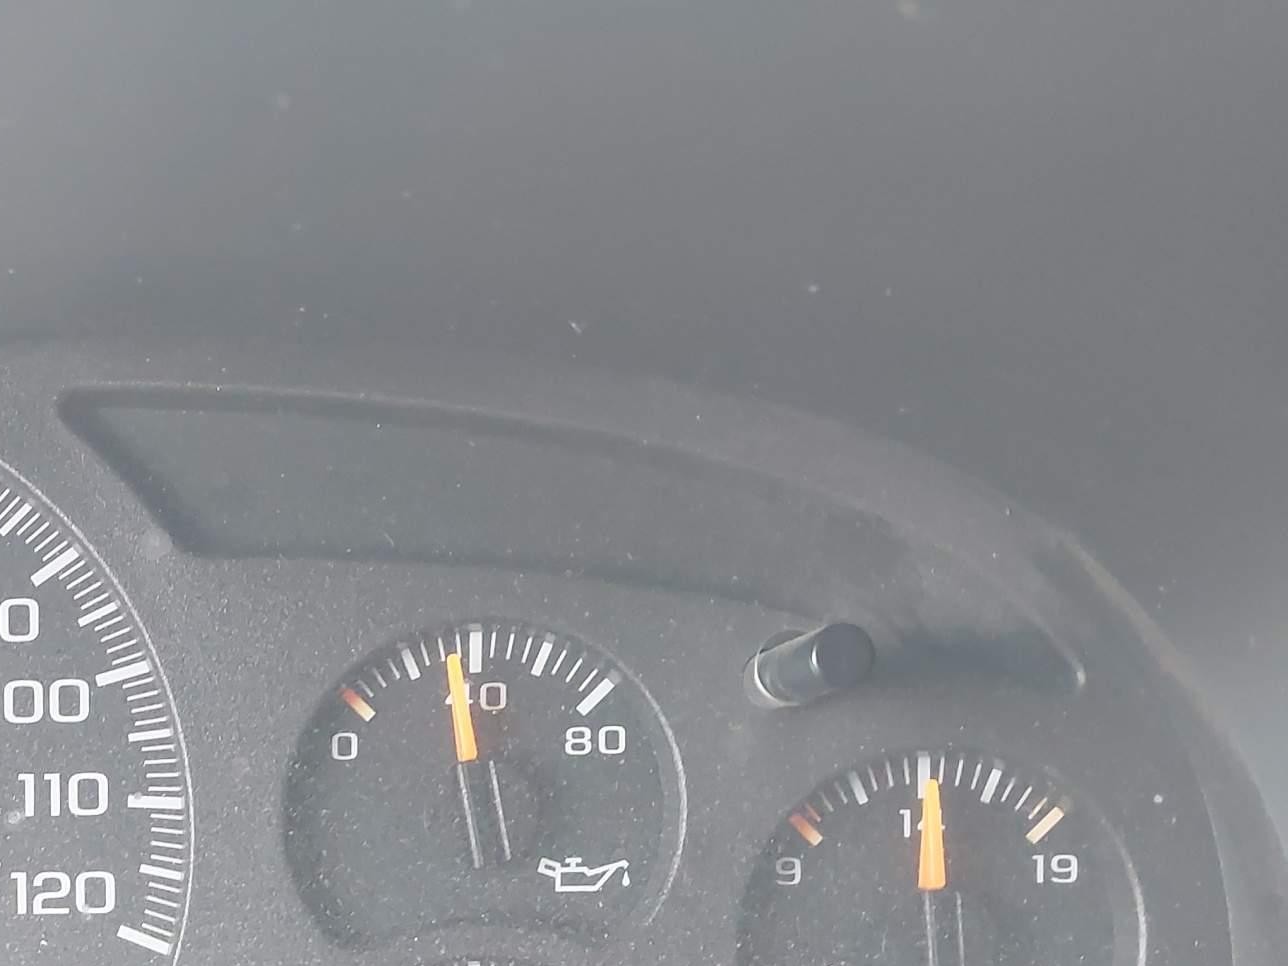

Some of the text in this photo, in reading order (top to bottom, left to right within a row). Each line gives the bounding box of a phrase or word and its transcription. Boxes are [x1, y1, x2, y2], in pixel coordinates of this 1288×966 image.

[331, 732, 358, 761] 0
[564, 725, 626, 755] 80
[17, 772, 109, 817] 110
[899, 809, 945, 838] 1
[775, 857, 802, 886] 9
[1031, 853, 1079, 884] 19
[10, 871, 115, 915] 120
